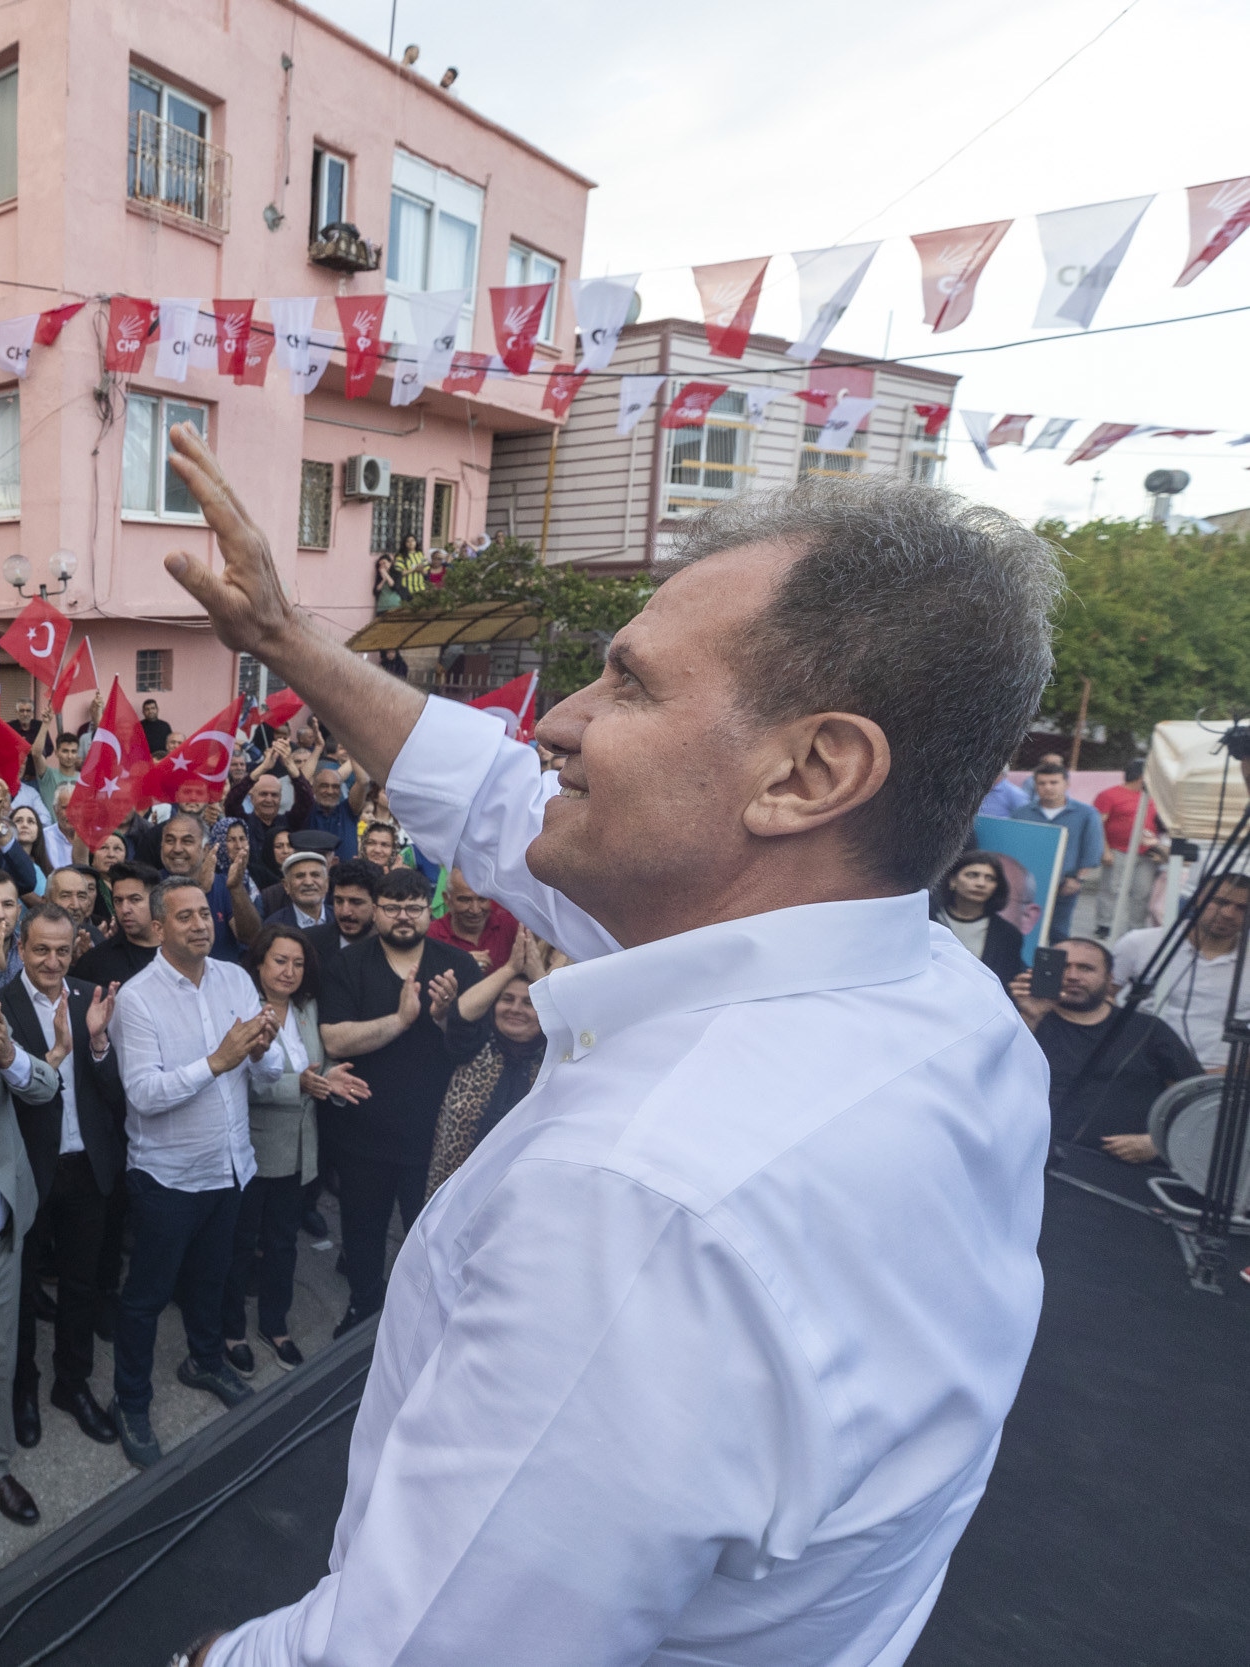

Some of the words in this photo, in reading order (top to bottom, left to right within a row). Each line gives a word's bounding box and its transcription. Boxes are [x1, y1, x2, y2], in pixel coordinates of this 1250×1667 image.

[116, 339, 141, 352] CHP
[172, 340, 191, 355] CH
[6, 346, 32, 360] CH
[245, 355, 262, 367] HP
